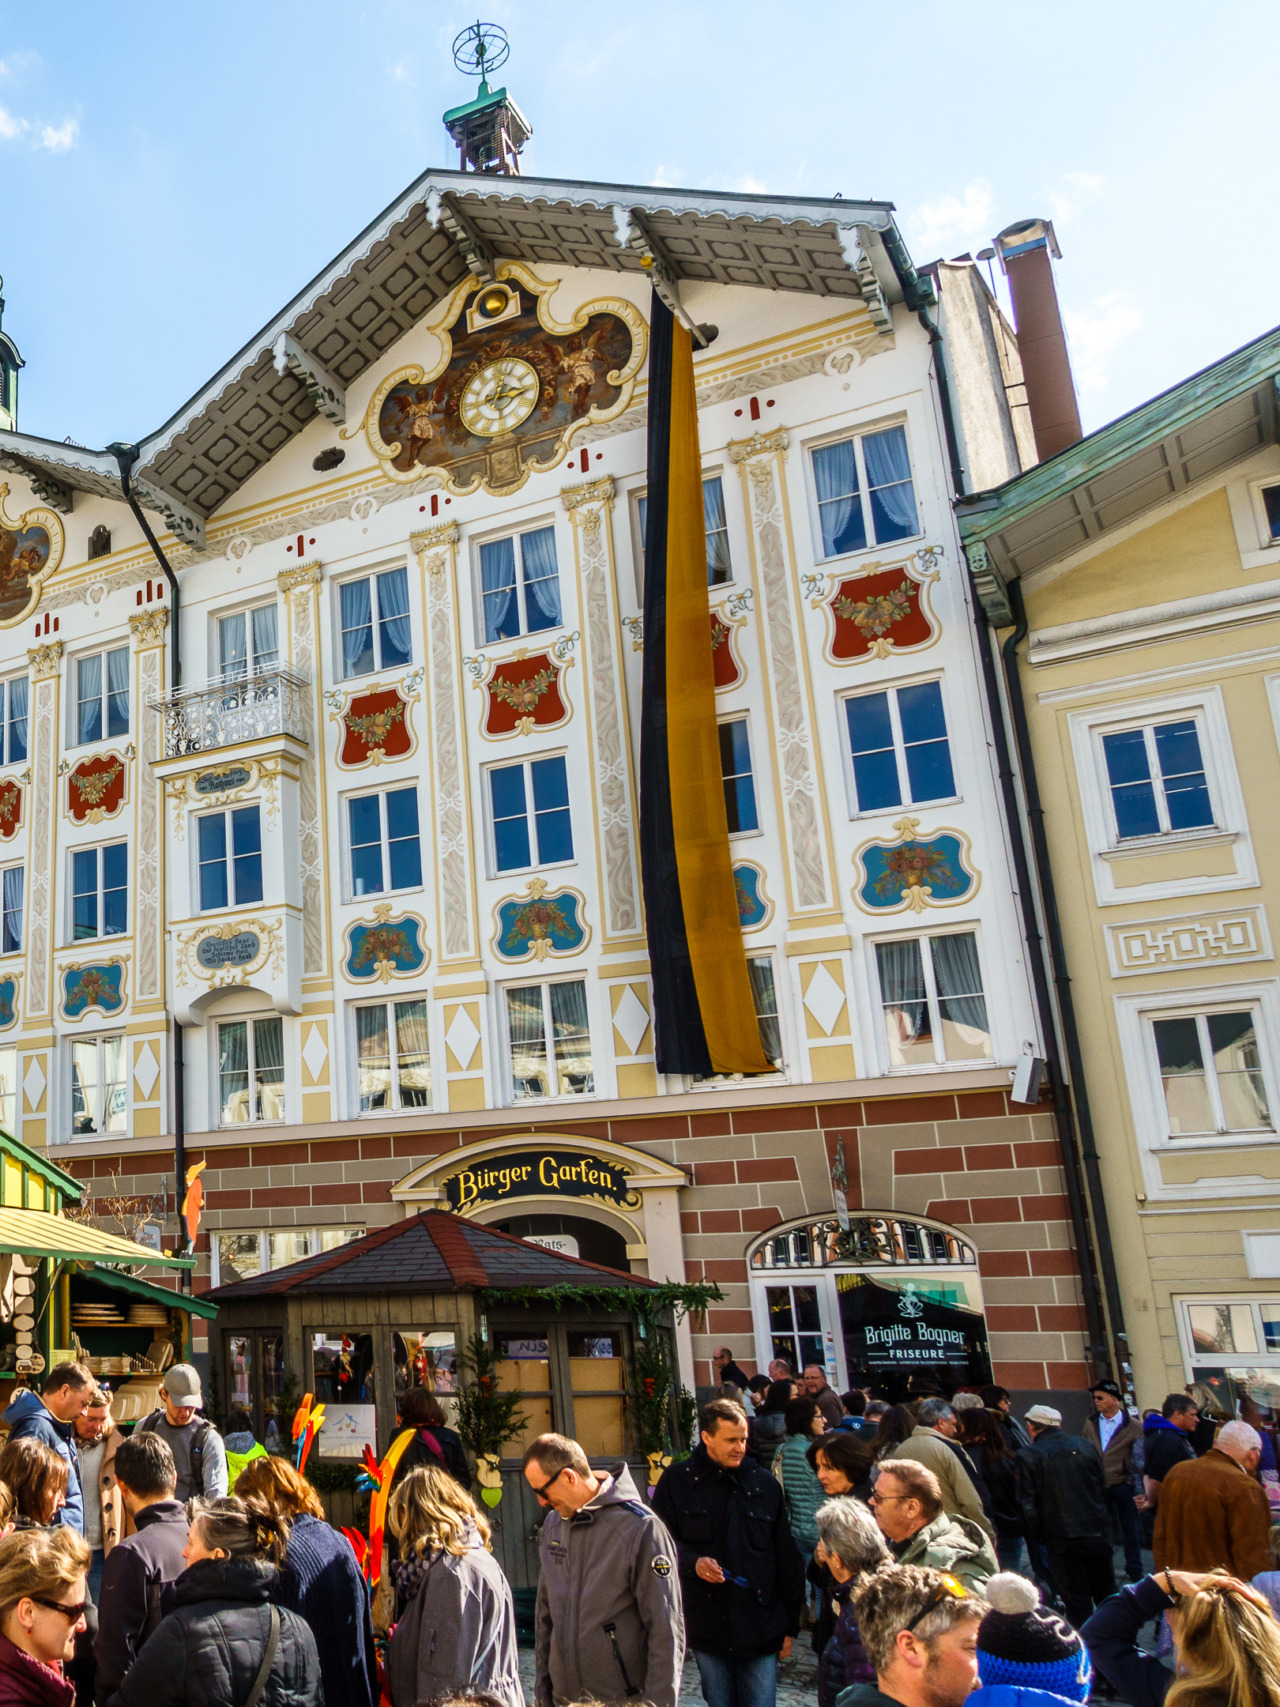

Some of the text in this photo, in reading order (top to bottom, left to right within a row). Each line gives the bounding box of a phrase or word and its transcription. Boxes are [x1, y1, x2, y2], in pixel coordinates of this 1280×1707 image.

[457, 1165, 531, 1207] Bürger
[864, 1322, 965, 1347] Brigitte Bogner
[889, 1349, 945, 1359] FRISEURE
